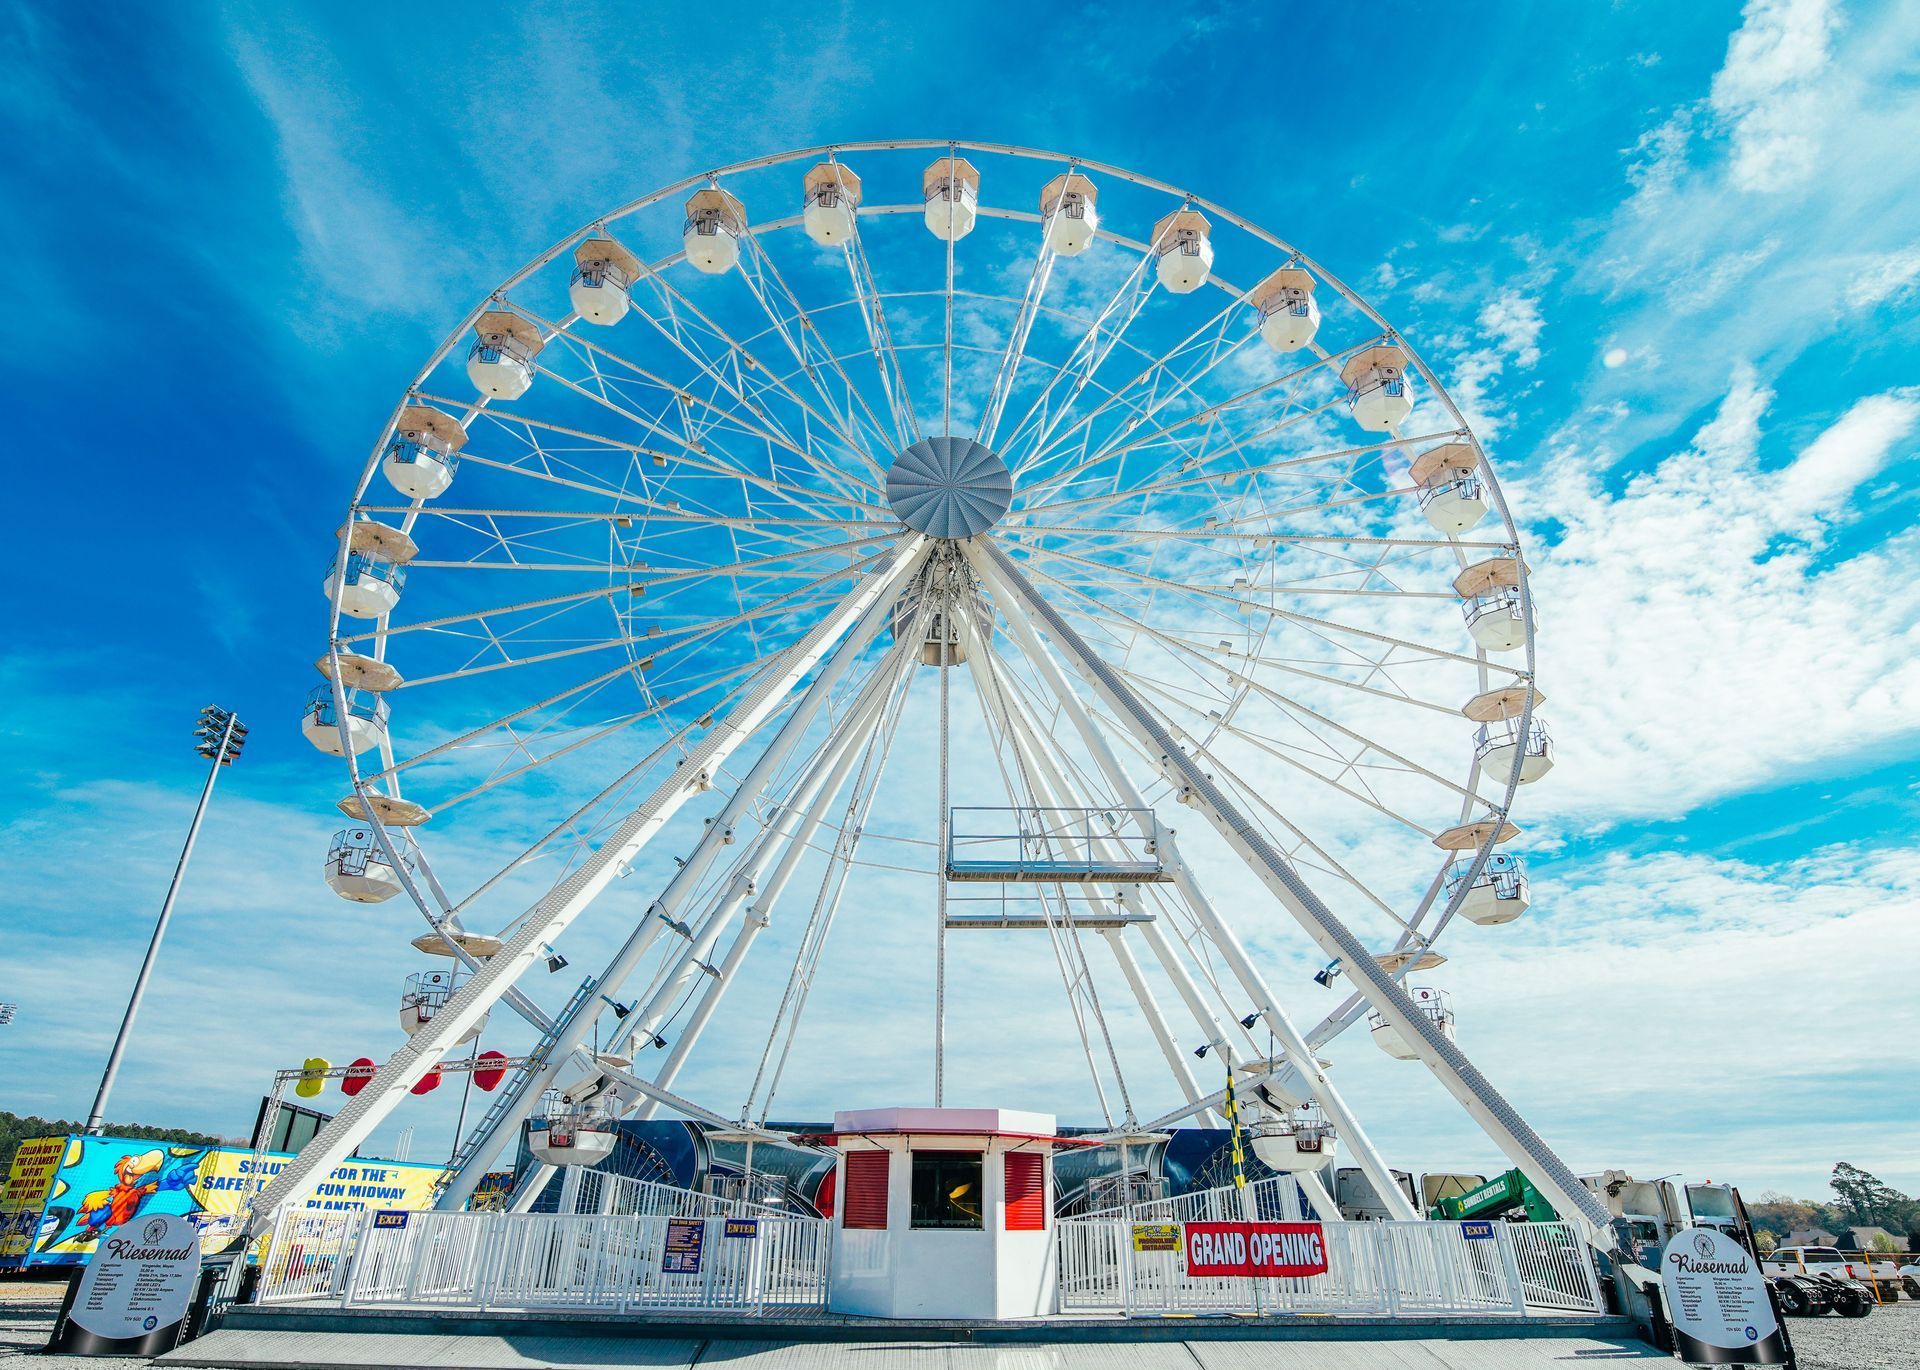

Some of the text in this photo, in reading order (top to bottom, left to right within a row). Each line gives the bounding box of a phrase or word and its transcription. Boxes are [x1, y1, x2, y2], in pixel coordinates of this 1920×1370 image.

[330, 1167, 359, 1181] FOR
[361, 1168, 387, 1182] THE
[316, 1183, 406, 1200] FUN MIDWAY
[378, 1214, 406, 1225] EXIT
[727, 1224, 756, 1233] ENTER
[1465, 1225, 1489, 1236] EXIT
[107, 1238, 194, 1261] Riesenrad
[1191, 1232, 1323, 1266] GRAND OPENING
[1669, 1253, 1749, 1274] Riesenrad
